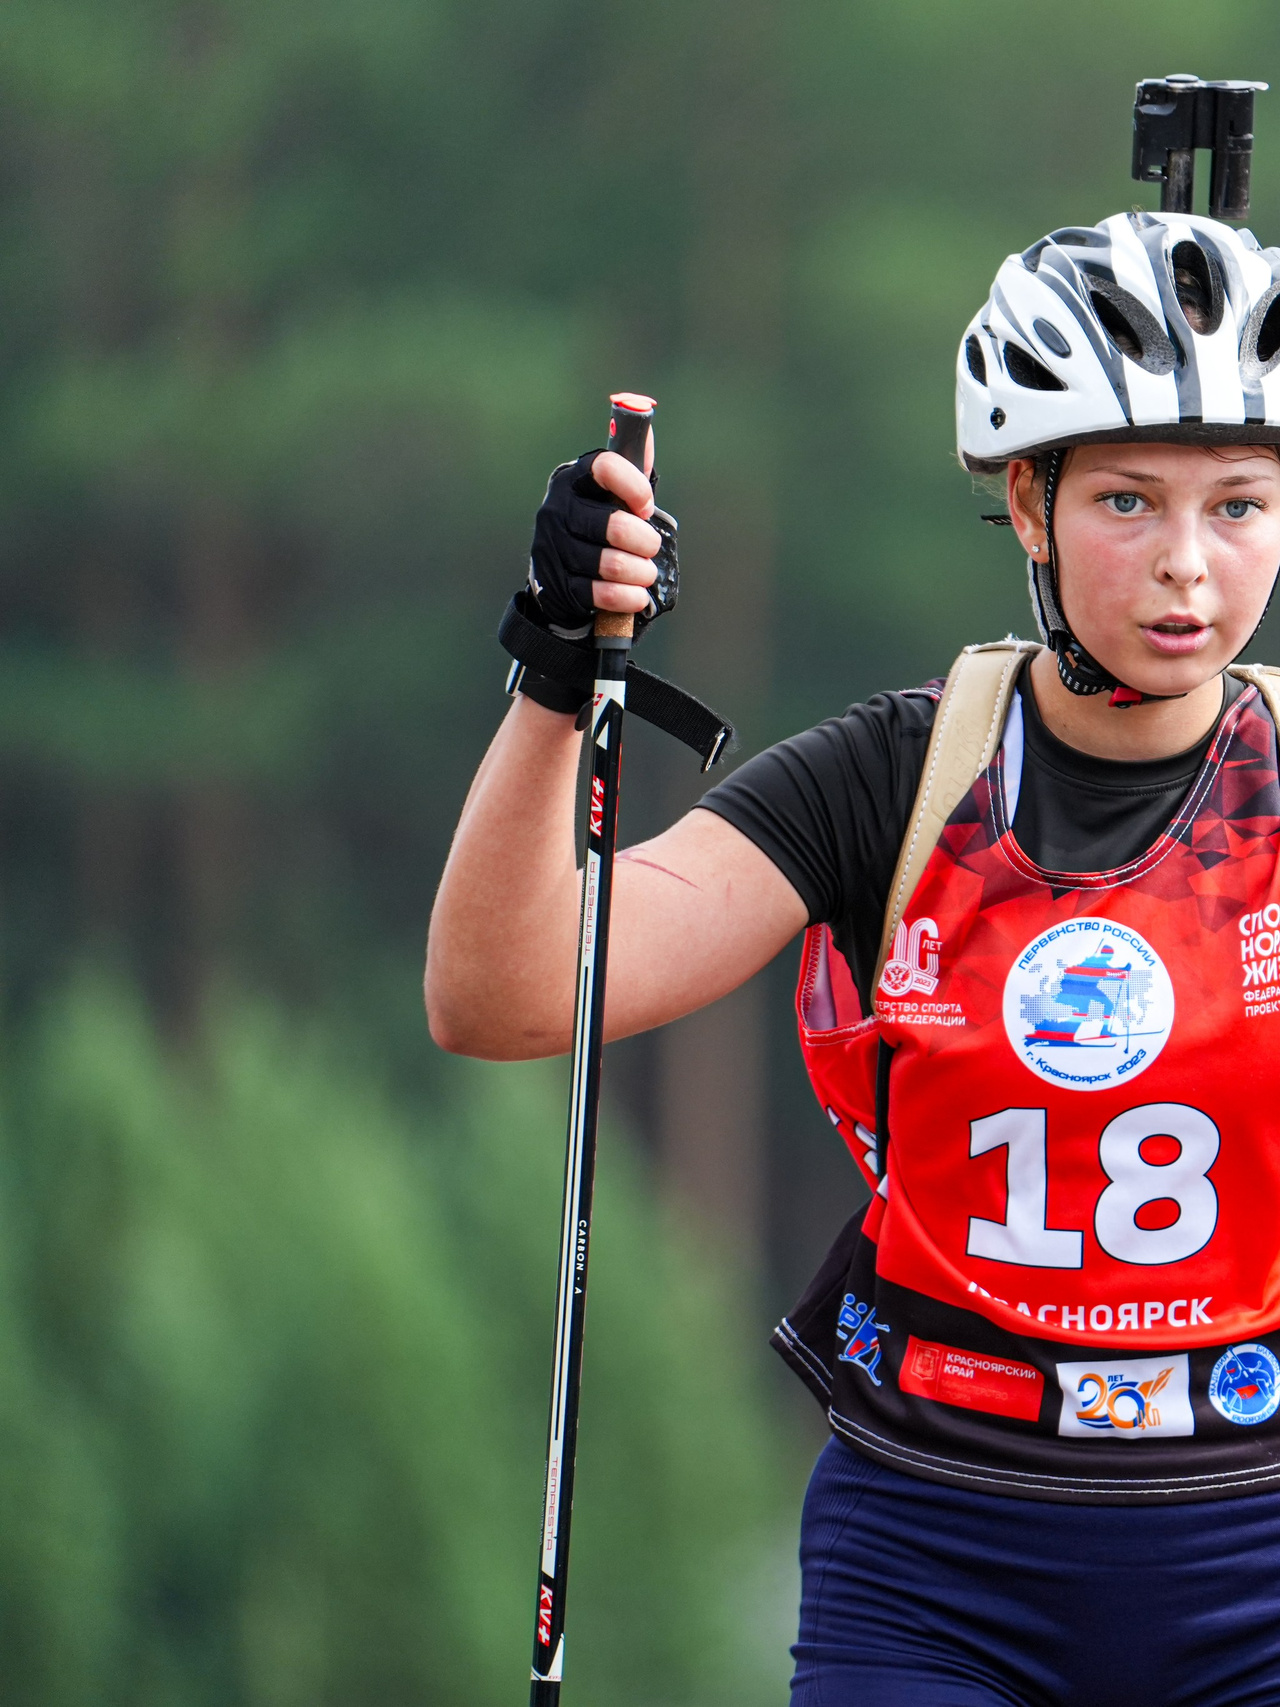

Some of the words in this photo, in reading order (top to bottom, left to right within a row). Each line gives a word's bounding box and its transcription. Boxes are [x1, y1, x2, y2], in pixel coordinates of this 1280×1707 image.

[585, 861, 597, 955] TEMPESTA
[922, 939, 943, 952] ЛЕТ
[1018, 921, 1100, 970] ПЕРВЕНСТВО
[1102, 924, 1156, 967] РОССИИ
[875, 1000, 919, 1013] ТЕРСТВО
[921, 1002, 963, 1014] СПОРТА
[897, 1013, 966, 1027] ФЕДЕРАЦИИ
[1035, 1057, 1112, 1084] Красноярск
[1116, 1048, 1147, 1075] 2023
[965, 1101, 1220, 1269] 18
[576, 1219, 587, 1271] CARBON
[967, 1281, 1213, 1332] АСНОЯРСК
[946, 1352, 1036, 1379] КРАСНОЯРСКИЙ
[1107, 1374, 1124, 1383] ЛЕТ
[546, 1457, 558, 1552] TEMPESTA
